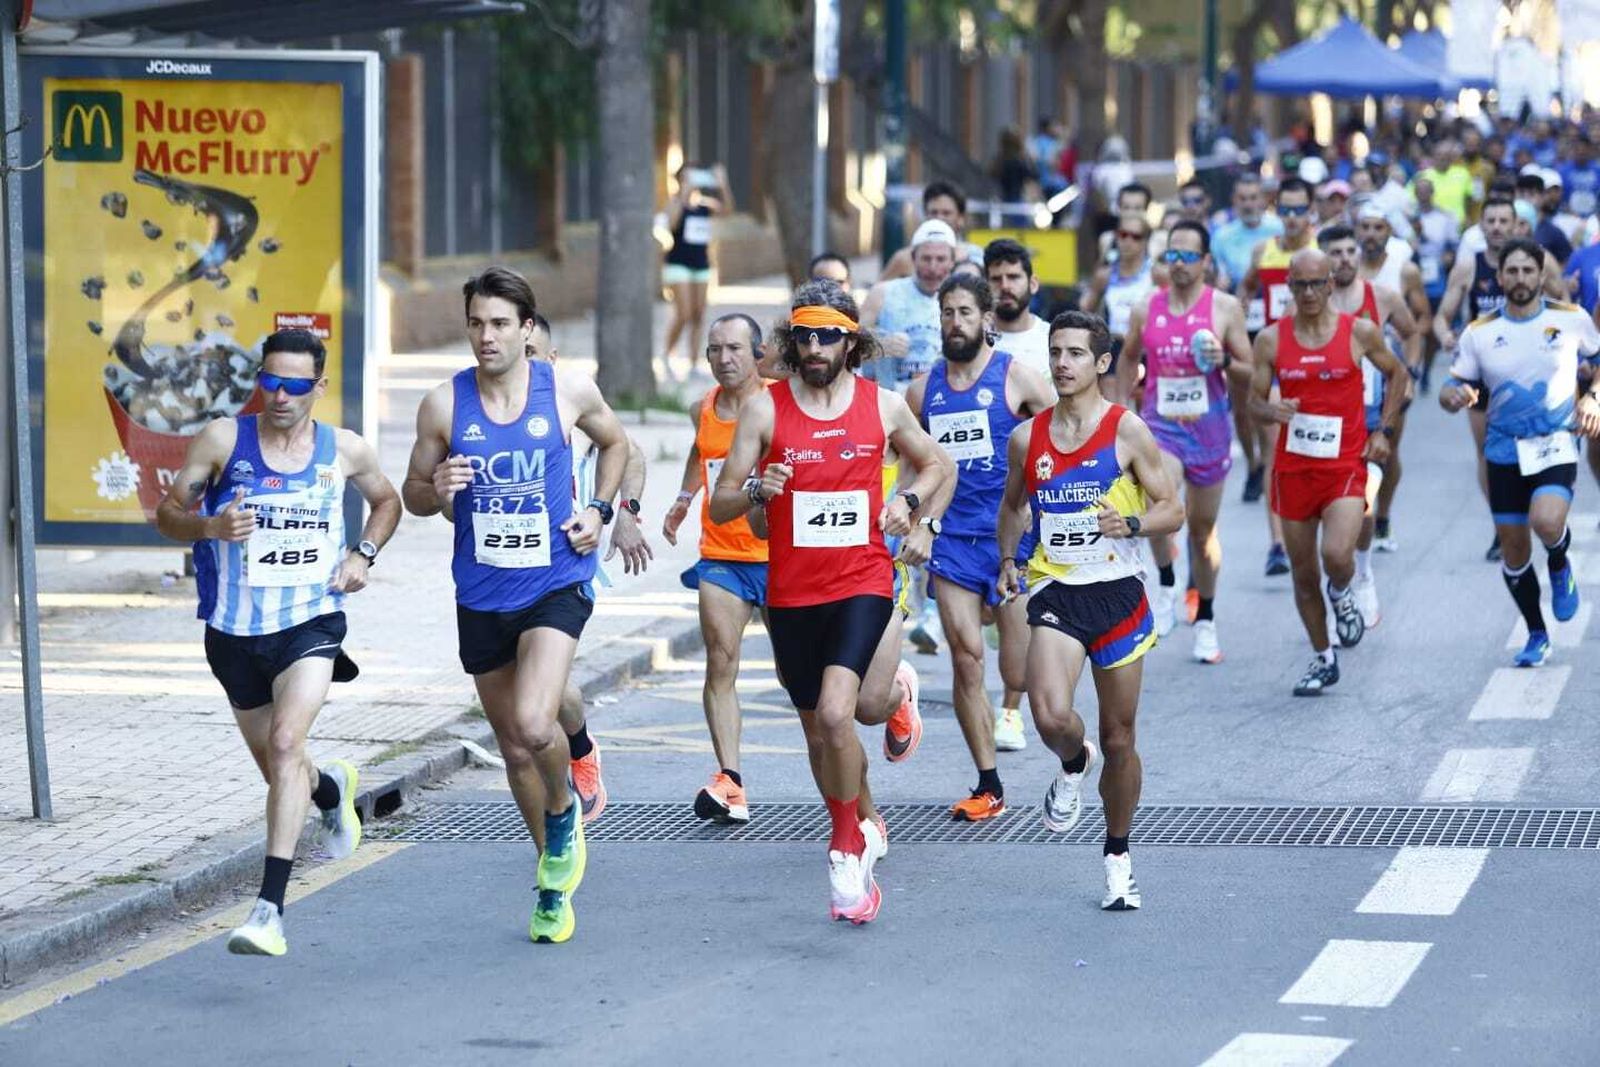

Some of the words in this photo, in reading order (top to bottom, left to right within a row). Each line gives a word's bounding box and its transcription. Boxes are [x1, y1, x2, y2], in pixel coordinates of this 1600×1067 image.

[146, 60, 212, 75] JCDecaux
[135, 100, 266, 135] Nuevo
[938, 428, 984, 443] 483
[469, 448, 546, 484] RCM
[1036, 487, 1101, 503] PALACIEGO
[807, 511, 858, 527] 413
[484, 533, 541, 549] 235
[1049, 531, 1103, 547] 257
[258, 548, 319, 565] 485
